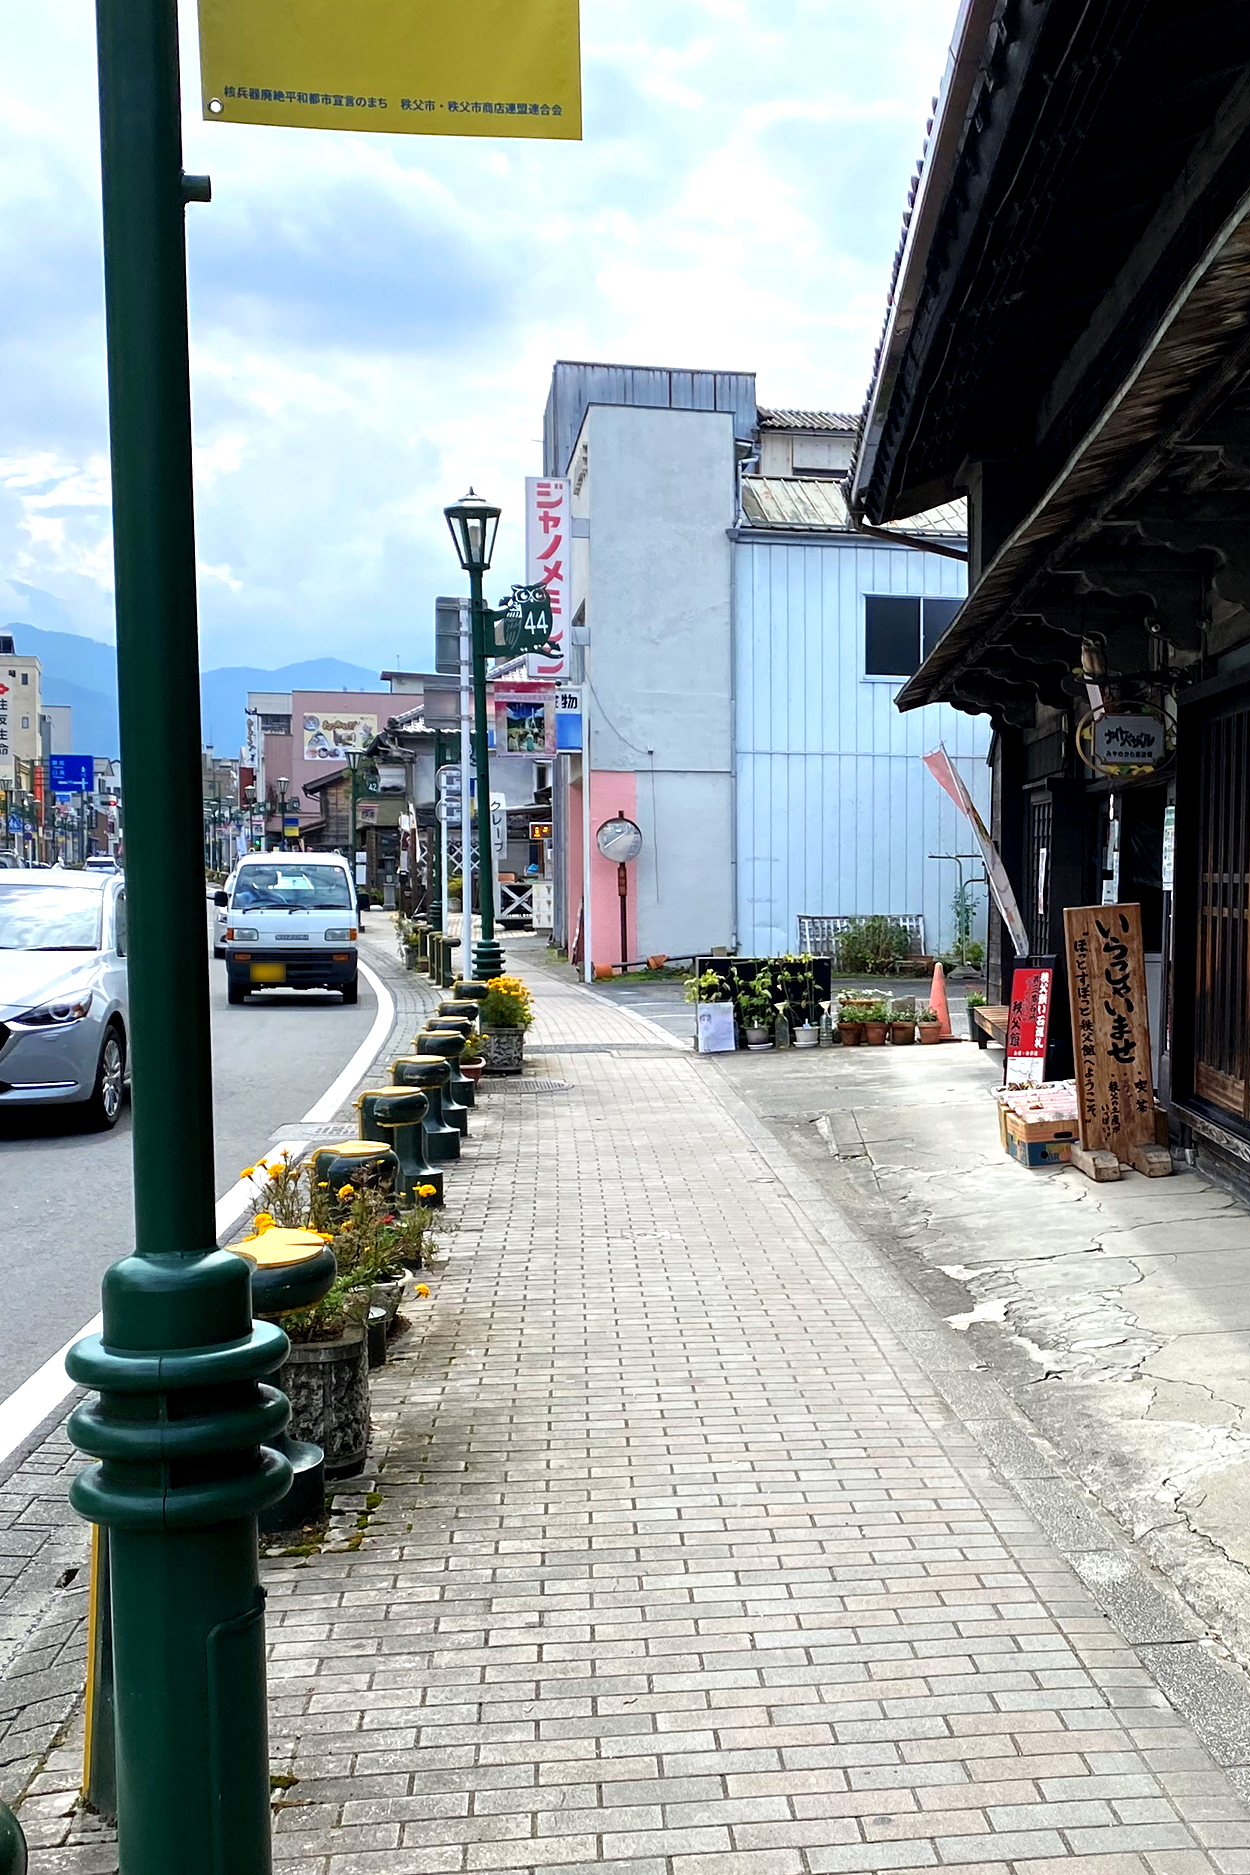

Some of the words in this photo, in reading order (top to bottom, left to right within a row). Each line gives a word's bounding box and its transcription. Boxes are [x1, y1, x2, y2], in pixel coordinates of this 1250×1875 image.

[224, 85, 388, 109] 核兵器廃絶平和都市宣言のまち
[535, 481, 565, 674] ジャノメミン
[523, 610, 549, 636] 44
[1095, 913, 1137, 1064] いらっしゃいませ
